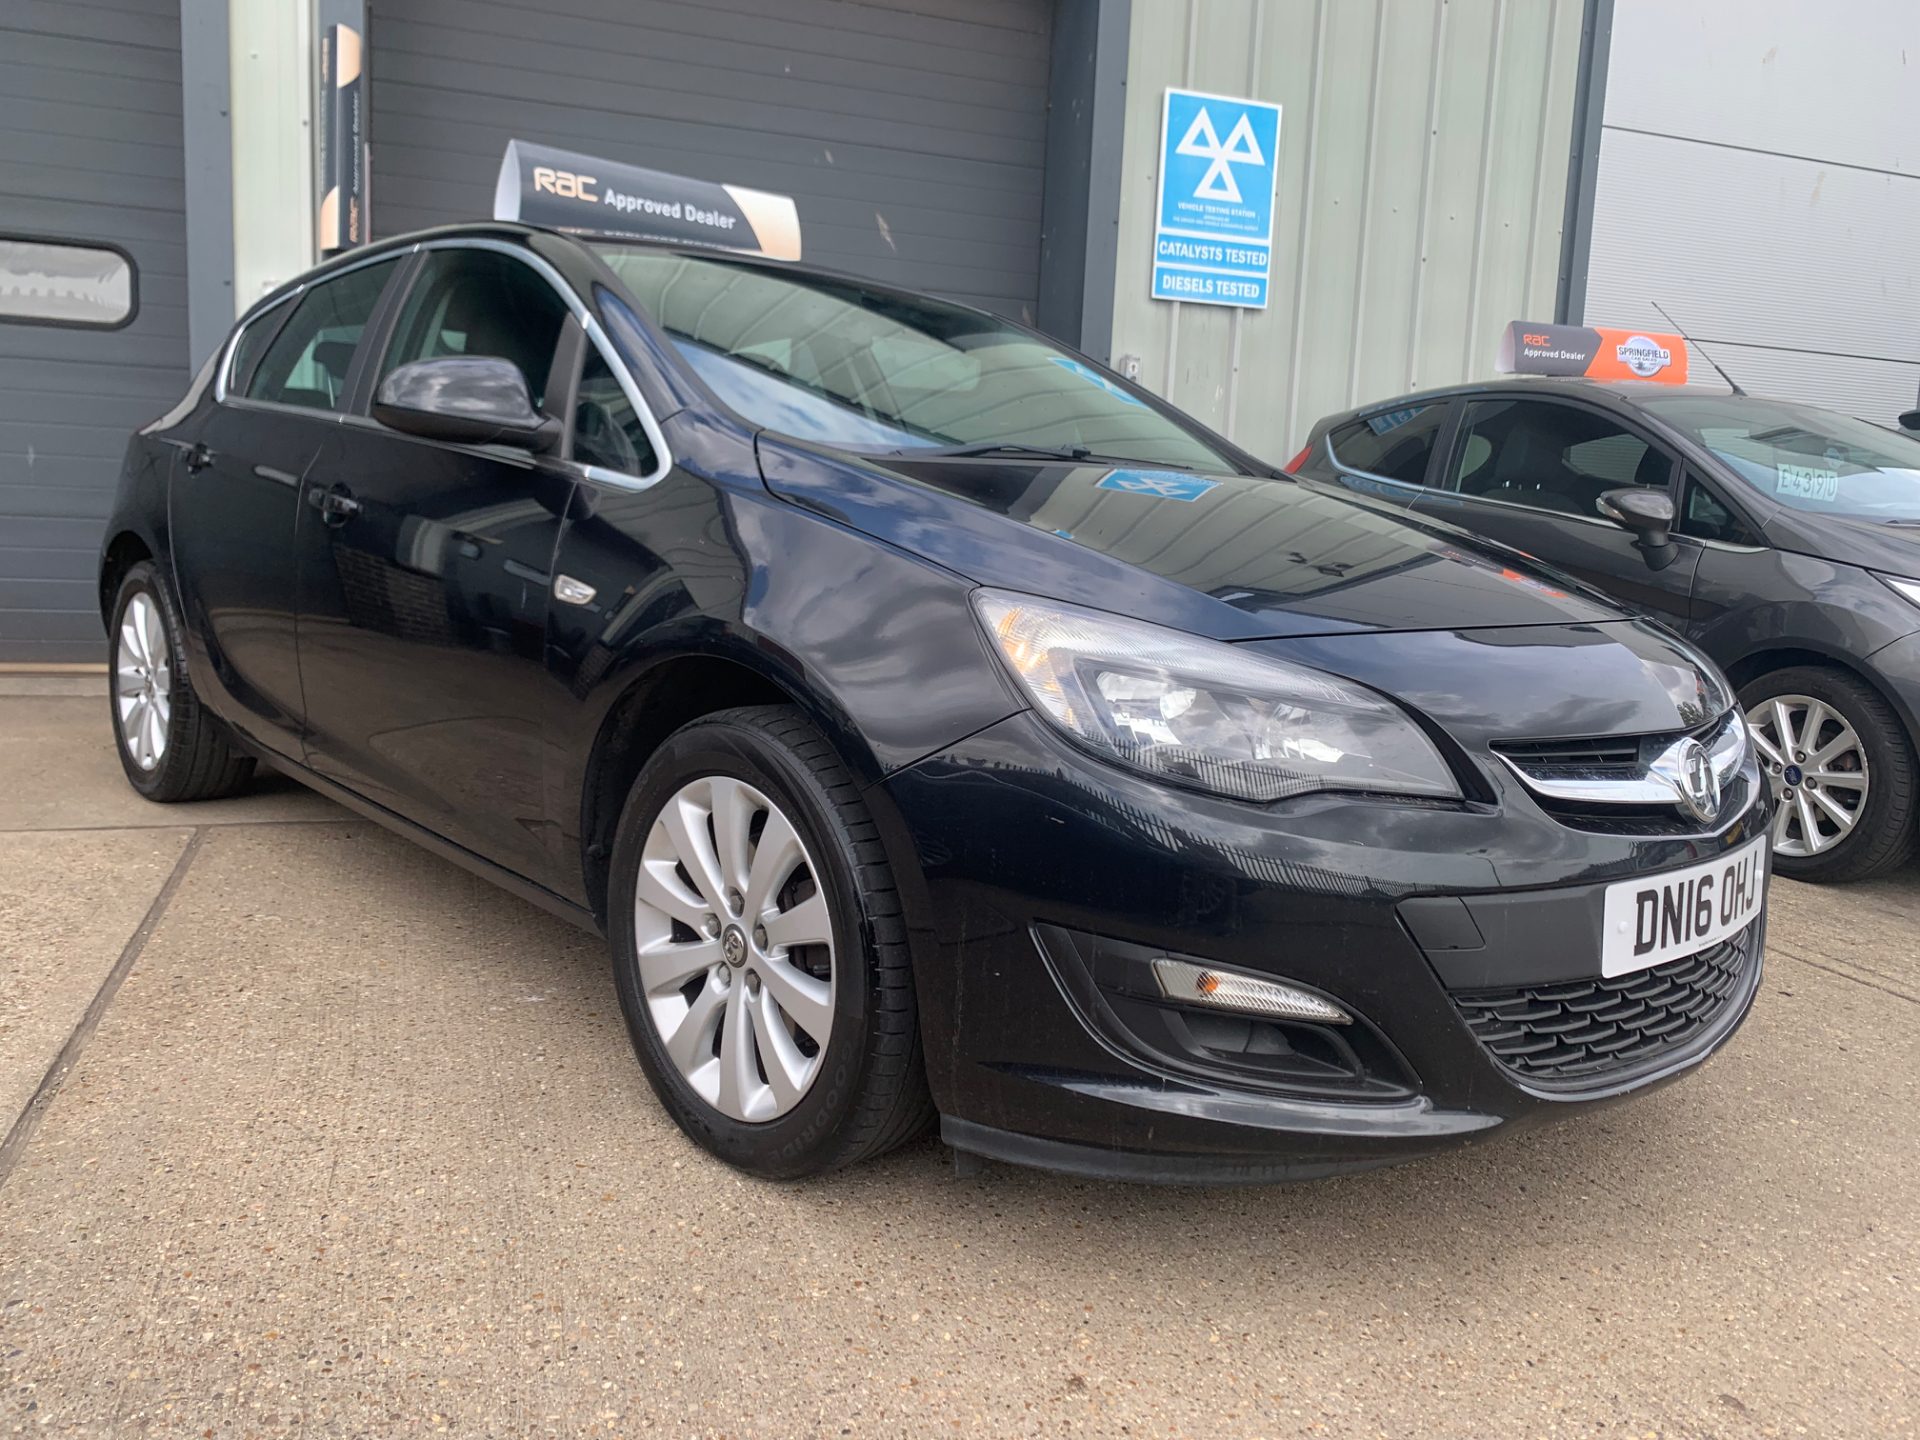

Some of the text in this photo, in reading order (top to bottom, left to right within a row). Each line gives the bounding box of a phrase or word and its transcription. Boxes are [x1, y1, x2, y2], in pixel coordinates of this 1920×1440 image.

[604, 187, 681, 219] Approved
[684, 204, 736, 230] Dealer
[1178, 201, 1256, 219] VEHICLE TESTING STATION
[1159, 241, 1267, 266] CATALYSTS TESTED
[1163, 274, 1259, 298] DIESELS TESTED
[1523, 347, 1586, 361] Approved Dealer
[1618, 346, 1669, 359] SPRINGFIELD
[1781, 469, 1836, 497] £4390
[1634, 850, 1758, 957] DN16 OHJ
